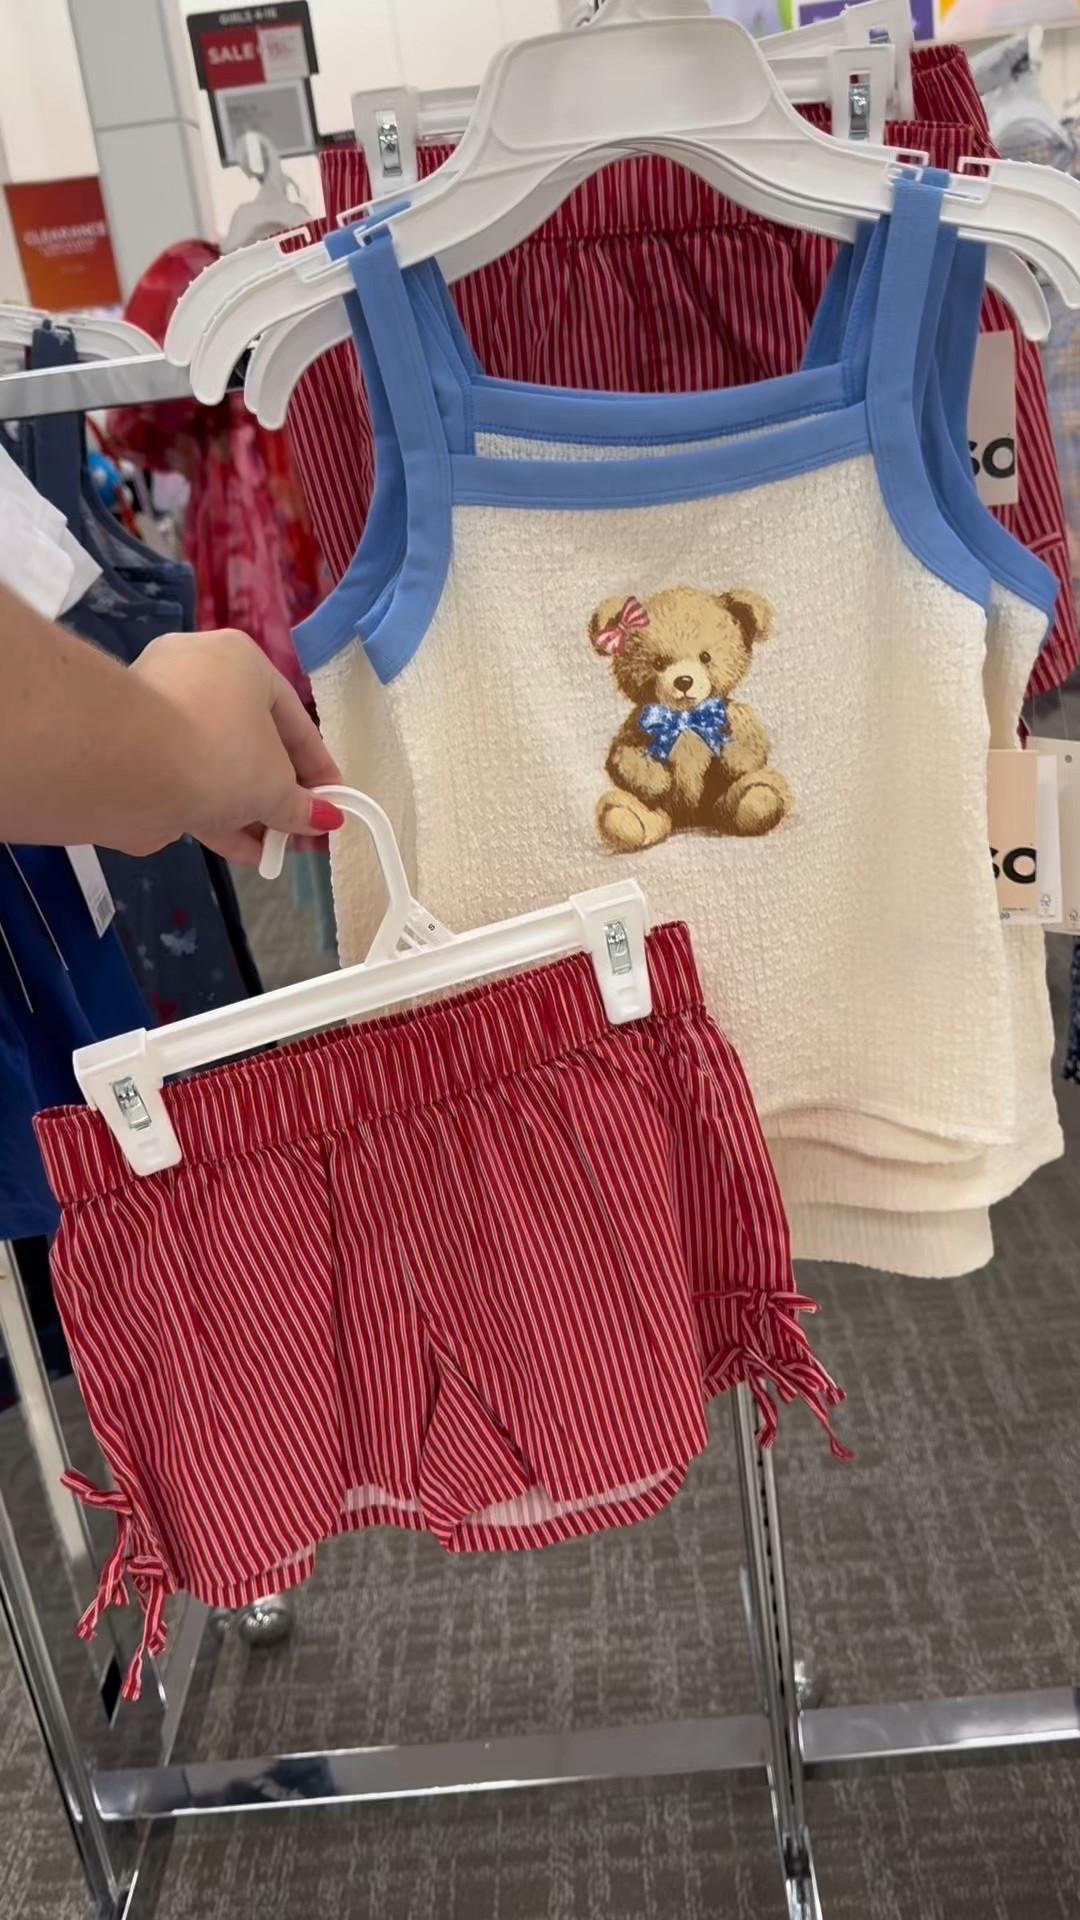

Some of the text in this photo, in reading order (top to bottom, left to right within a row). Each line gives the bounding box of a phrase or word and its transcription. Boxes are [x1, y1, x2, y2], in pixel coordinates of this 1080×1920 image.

[218, 9, 253, 26] GIRLS
[207, 42, 256, 65] SALE
[23, 220, 107, 247] CLEARANCE
